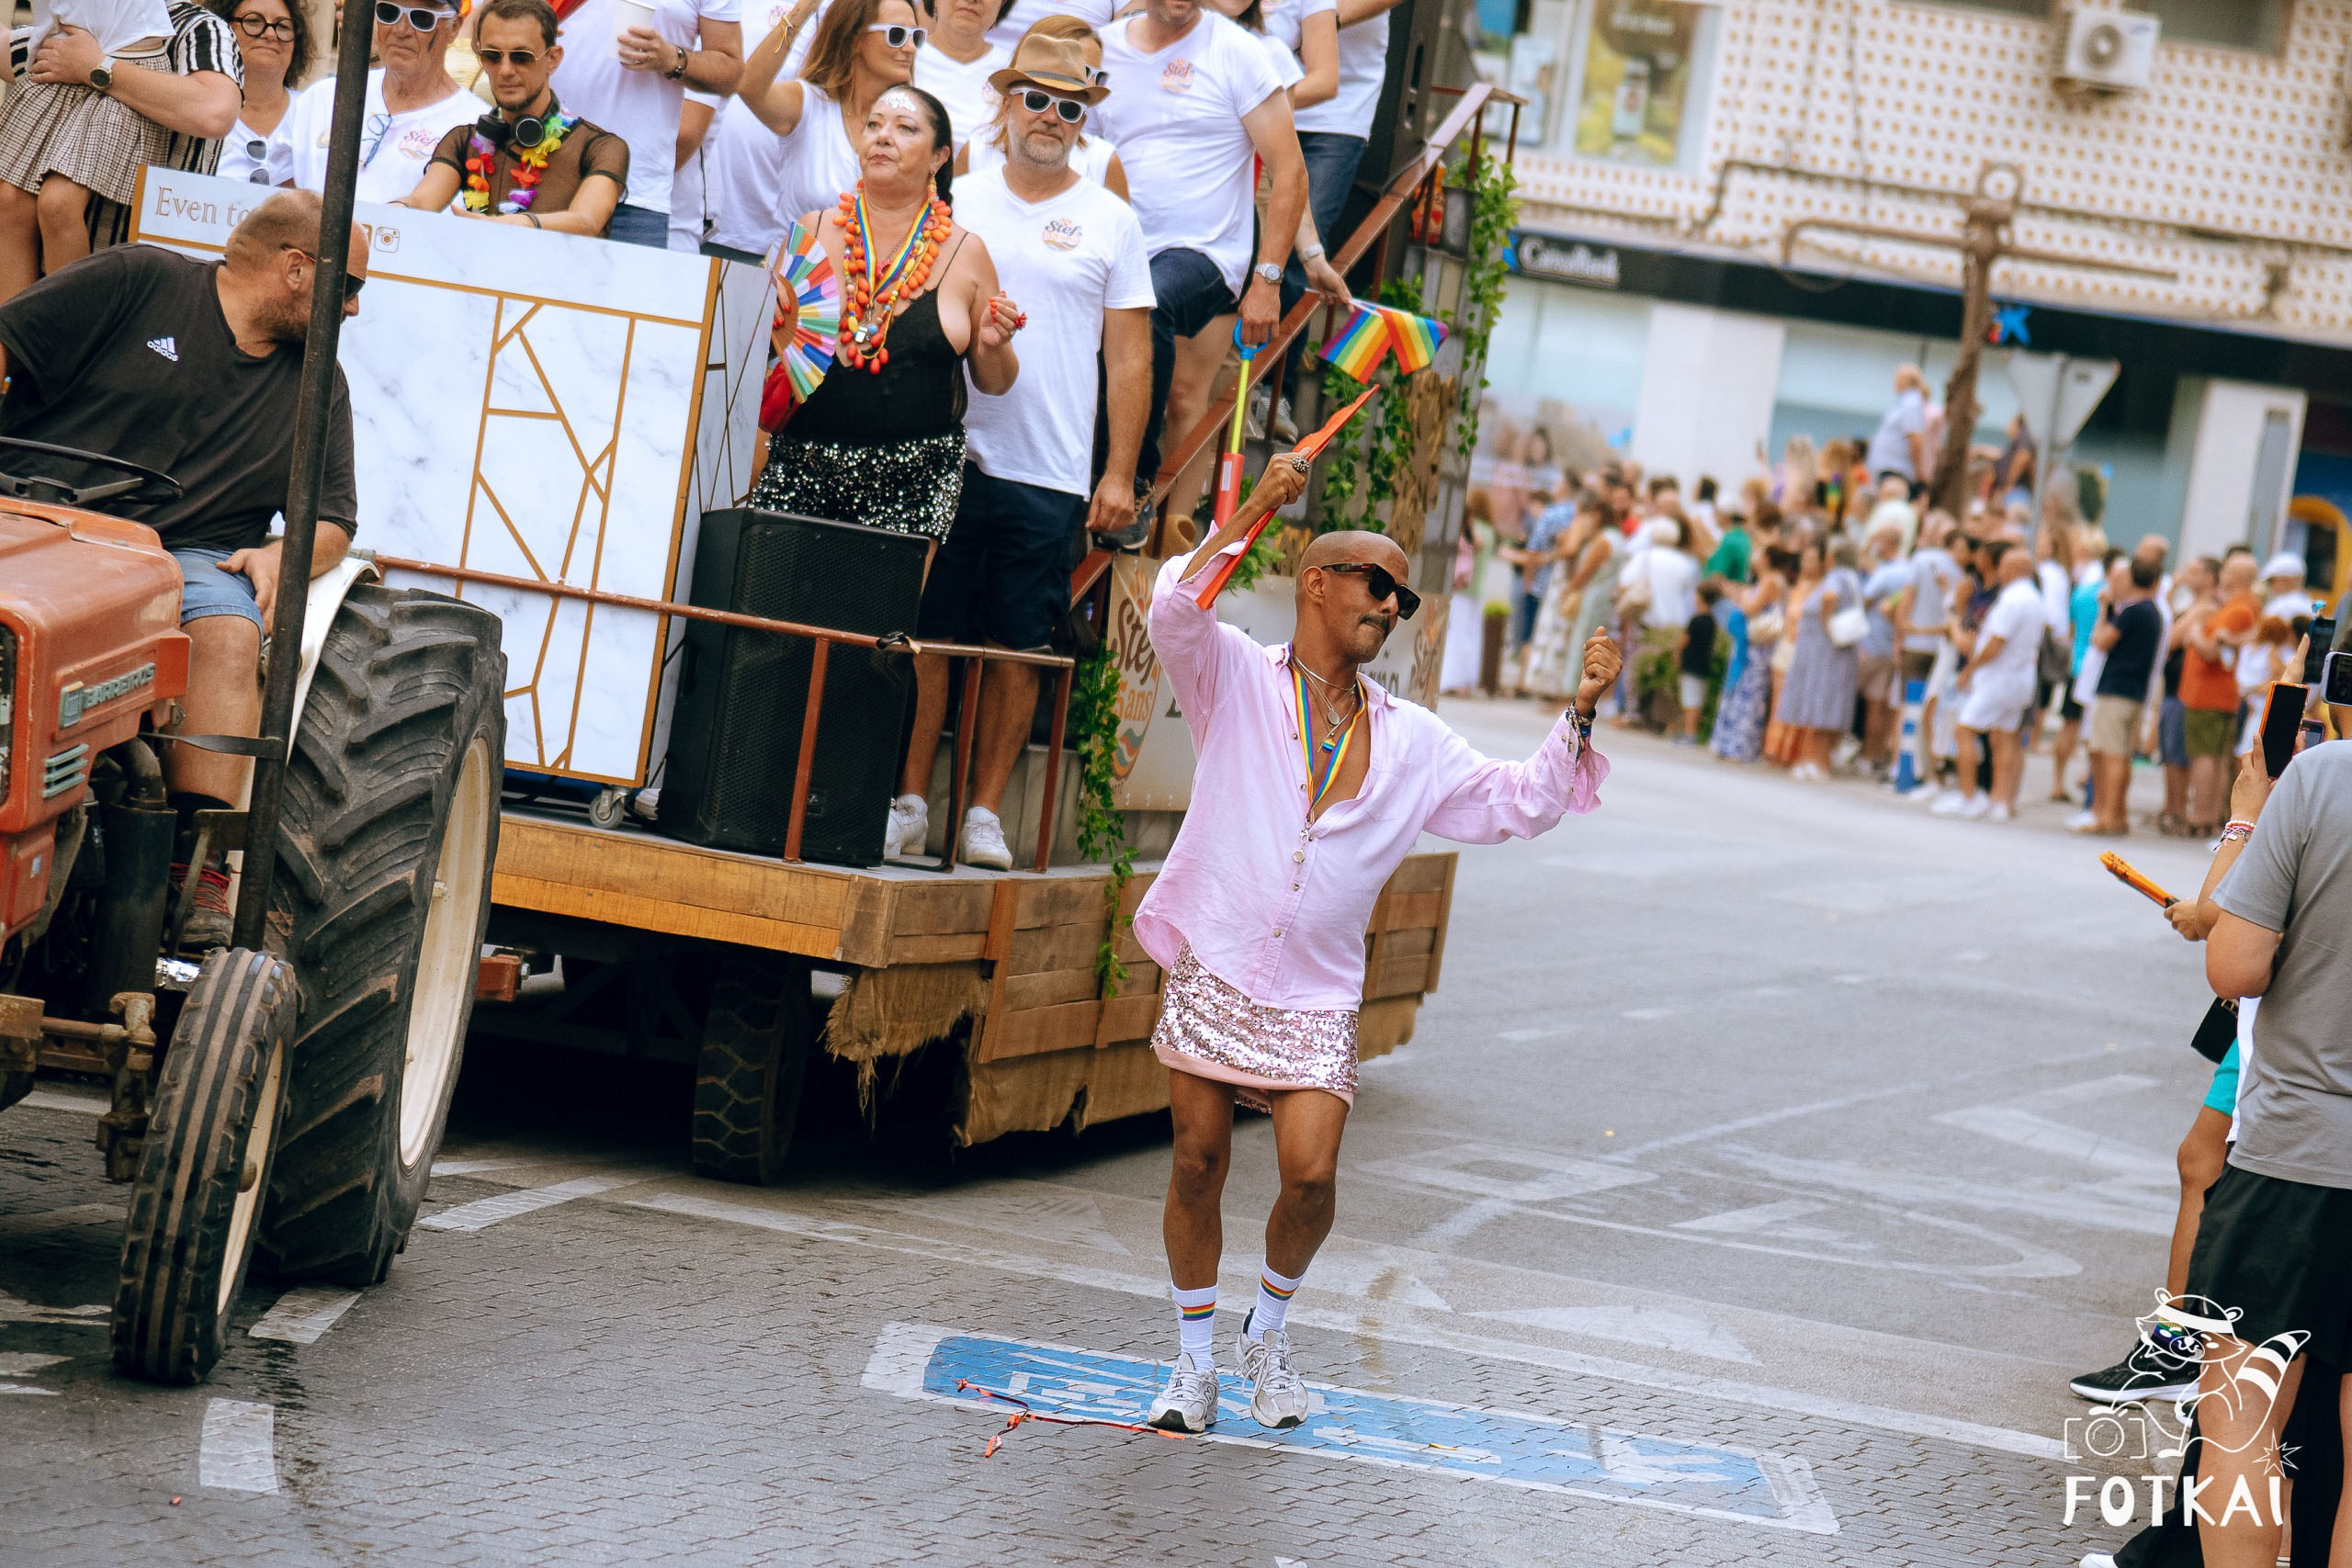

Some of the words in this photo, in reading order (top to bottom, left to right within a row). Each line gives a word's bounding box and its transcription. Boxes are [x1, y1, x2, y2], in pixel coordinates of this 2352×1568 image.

[153, 185, 218, 225] Even
[1045, 220, 1082, 237] Stef
[81, 661, 156, 710] BARREIROS
